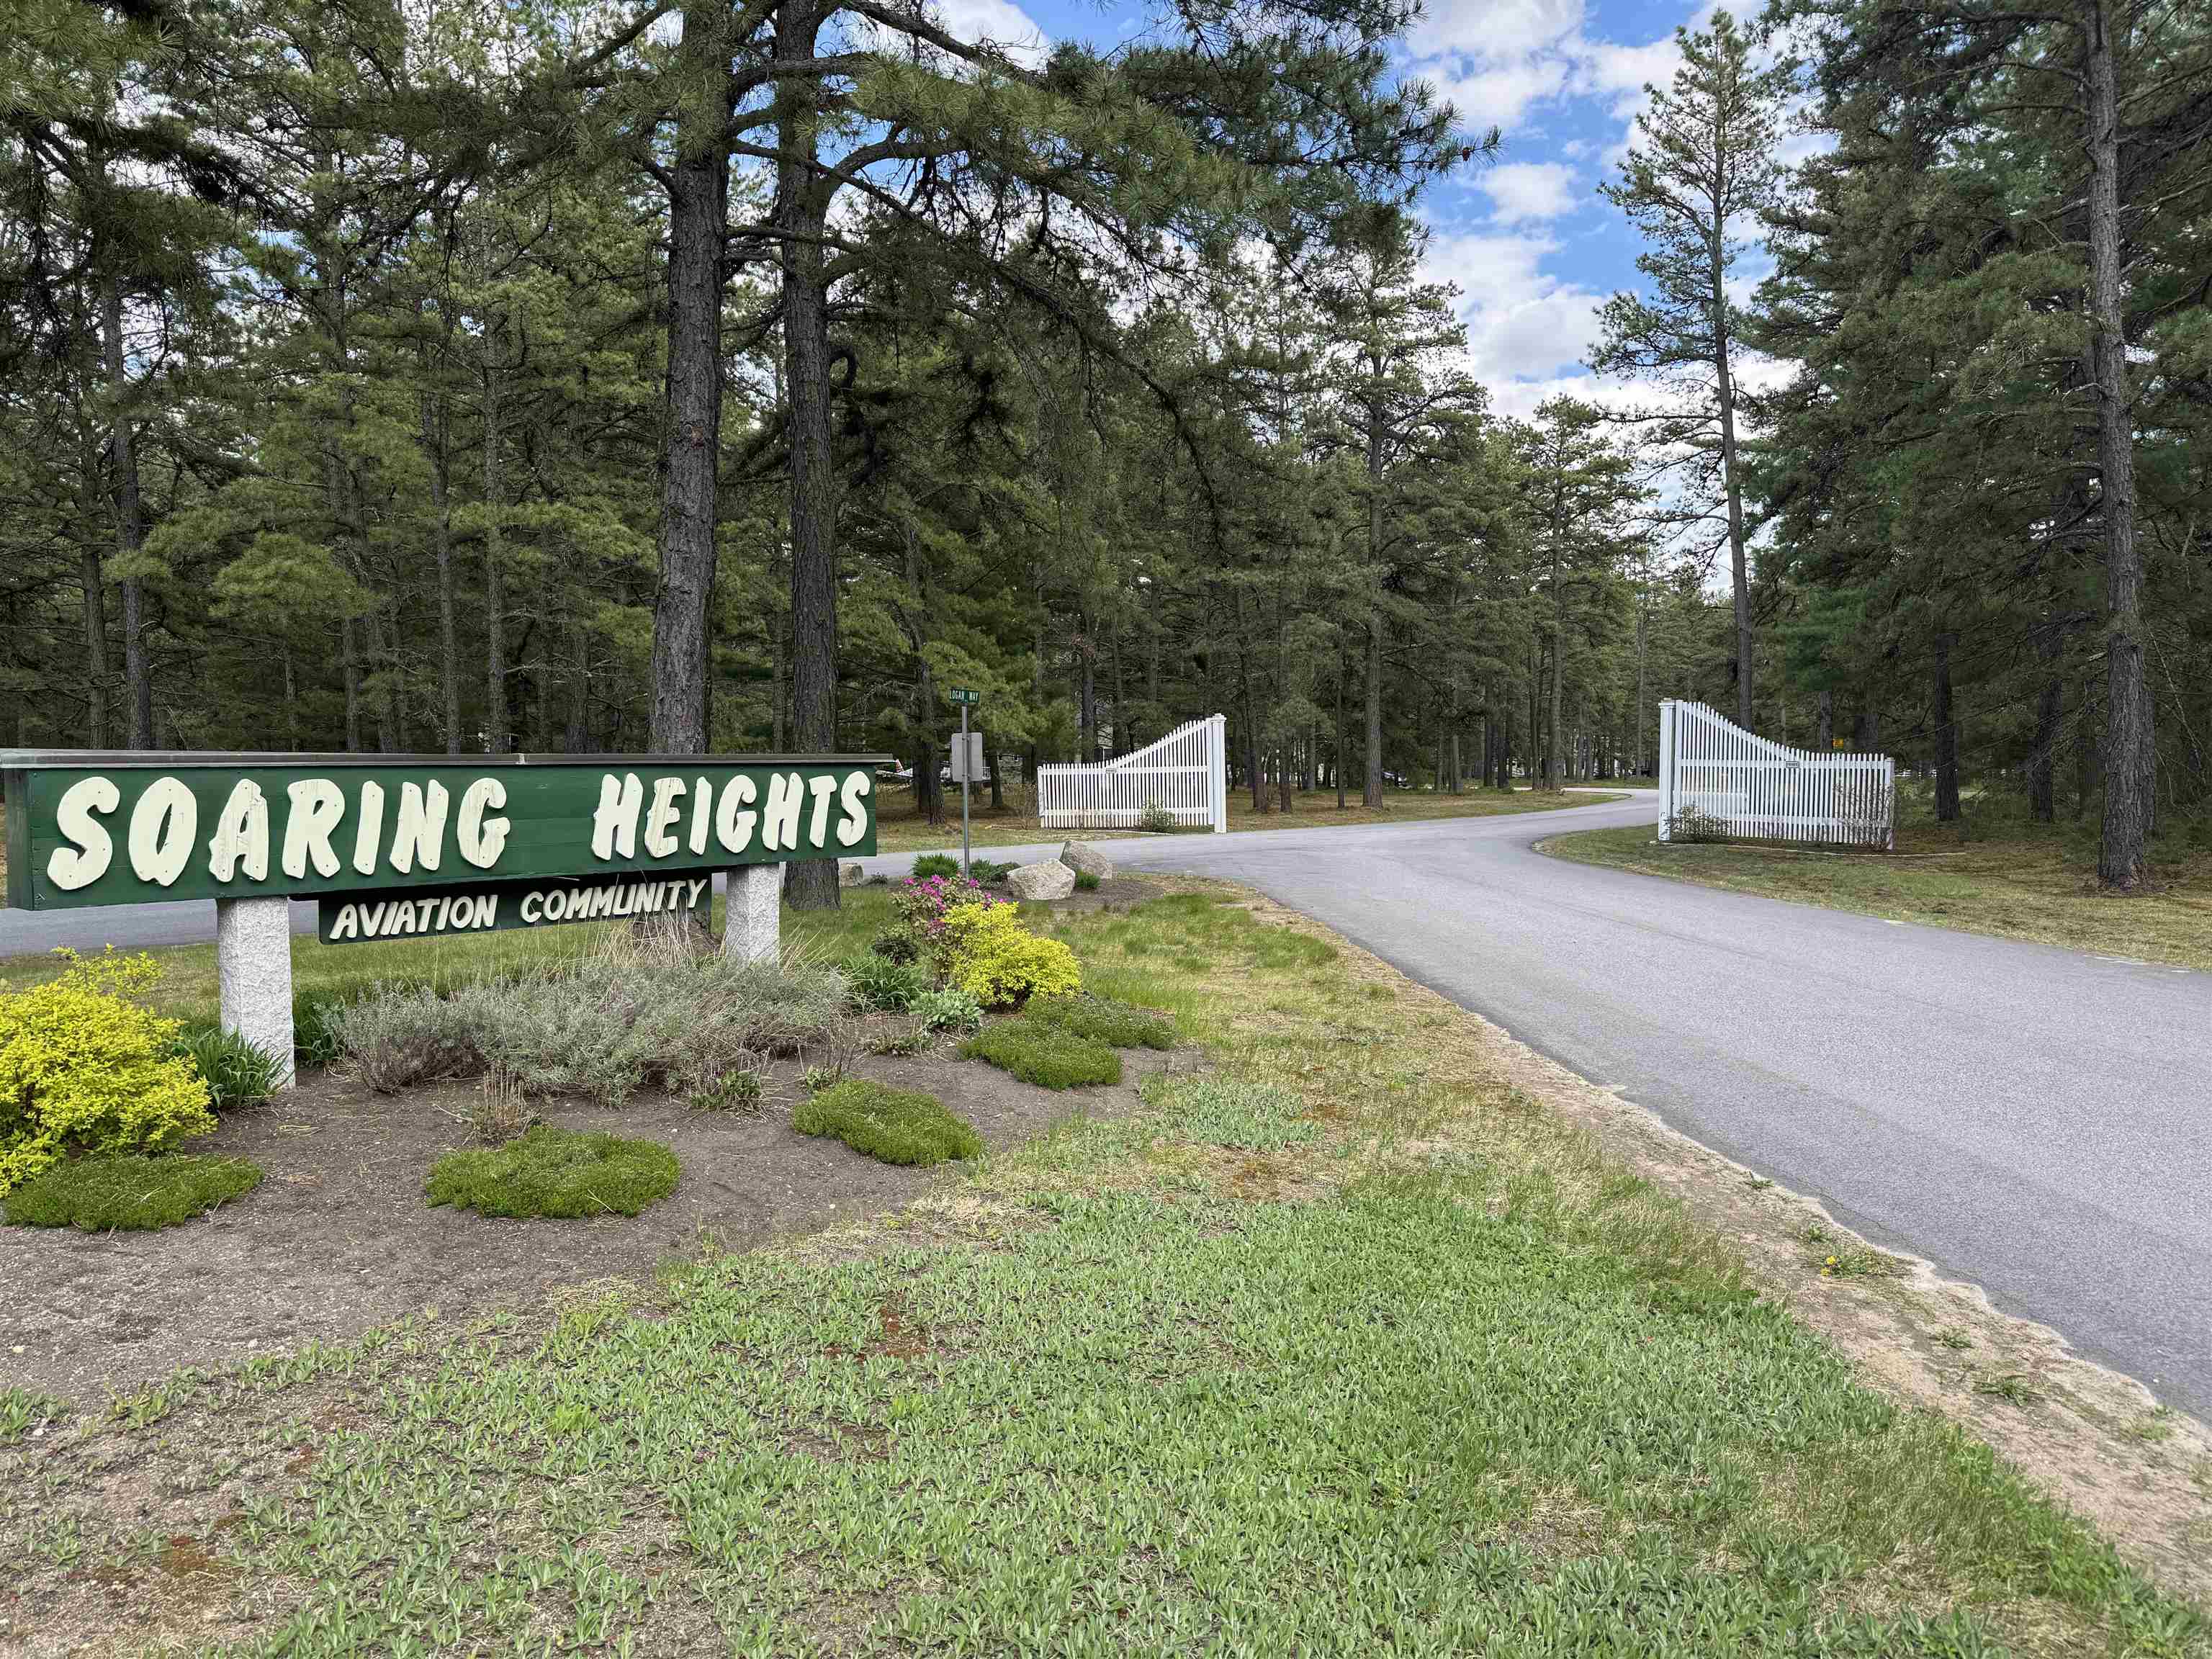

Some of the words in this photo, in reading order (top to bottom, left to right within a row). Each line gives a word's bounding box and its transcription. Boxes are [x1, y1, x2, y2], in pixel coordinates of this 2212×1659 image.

[968, 691, 979, 701] WAY
[47, 776, 511, 890] SOARING
[590, 770, 871, 860] HEIGHTS
[329, 894, 498, 939] AVIATION
[520, 878, 709, 923] COMMUNITY
